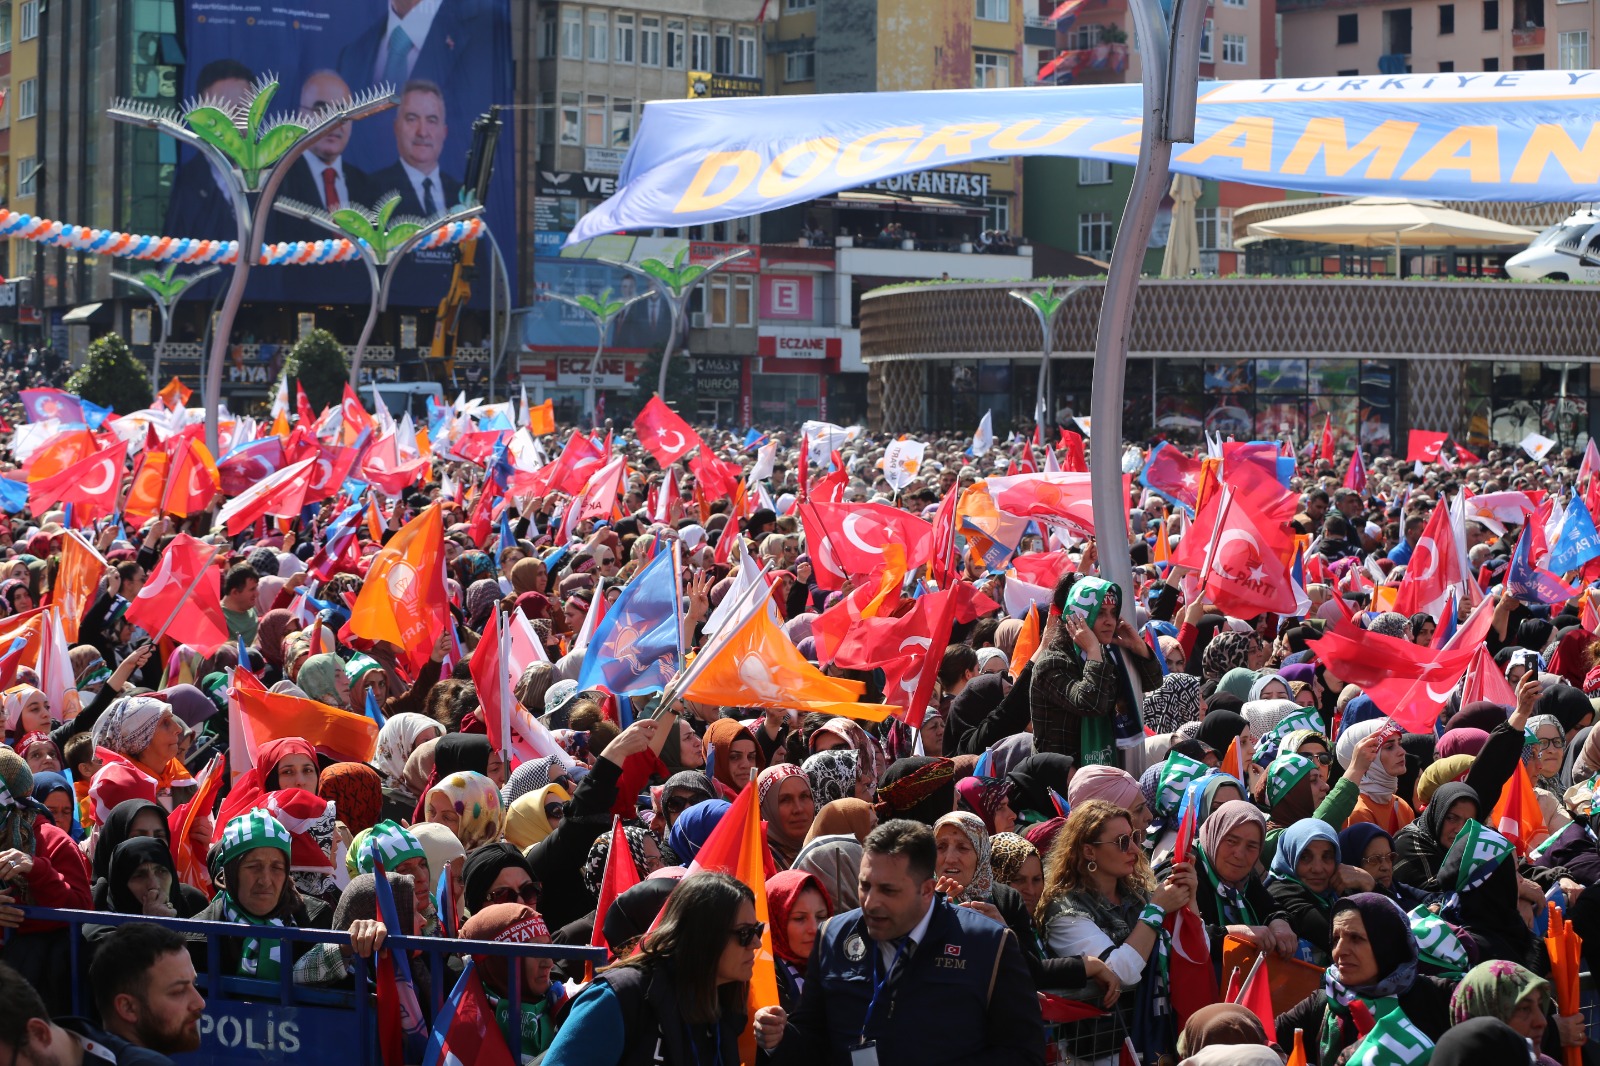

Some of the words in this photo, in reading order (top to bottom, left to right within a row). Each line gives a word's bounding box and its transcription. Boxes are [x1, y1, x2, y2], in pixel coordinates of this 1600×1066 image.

[779, 337, 824, 350] ECZANE
[934, 957, 966, 969] TEM
[196, 1010, 300, 1053] POLİS
